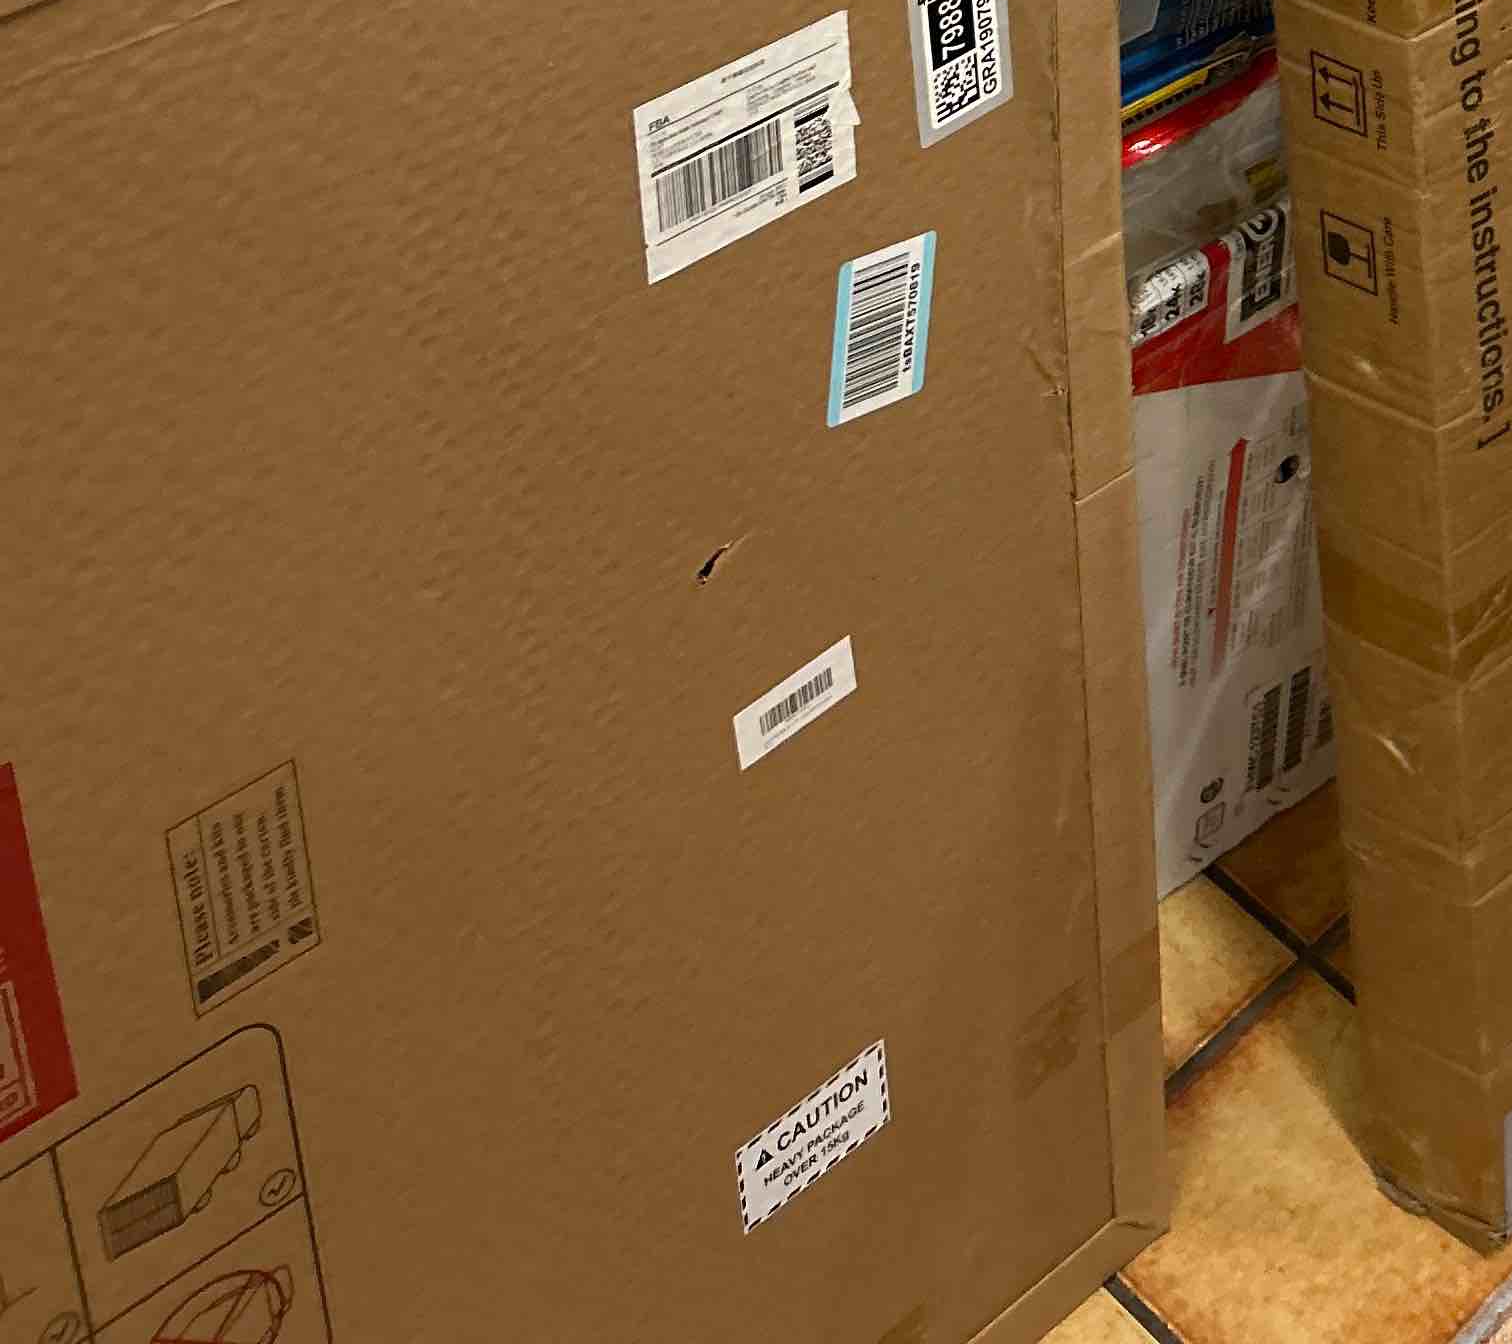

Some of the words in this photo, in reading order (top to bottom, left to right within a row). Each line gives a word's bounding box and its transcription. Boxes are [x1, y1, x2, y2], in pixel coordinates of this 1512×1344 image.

[649, 115, 671, 133] FBA
[1459, 70, 1488, 114] to
[1376, 126, 1388, 151] This
[1463, 119, 1490, 185] the
[1469, 186, 1506, 423] instructions.
[193, 903, 214, 967] Please
[776, 1068, 868, 1152] CAUTION
[763, 1148, 804, 1188] HEAVY
[807, 1100, 865, 1154] PACKAGE
[783, 1153, 817, 1187] OVER
